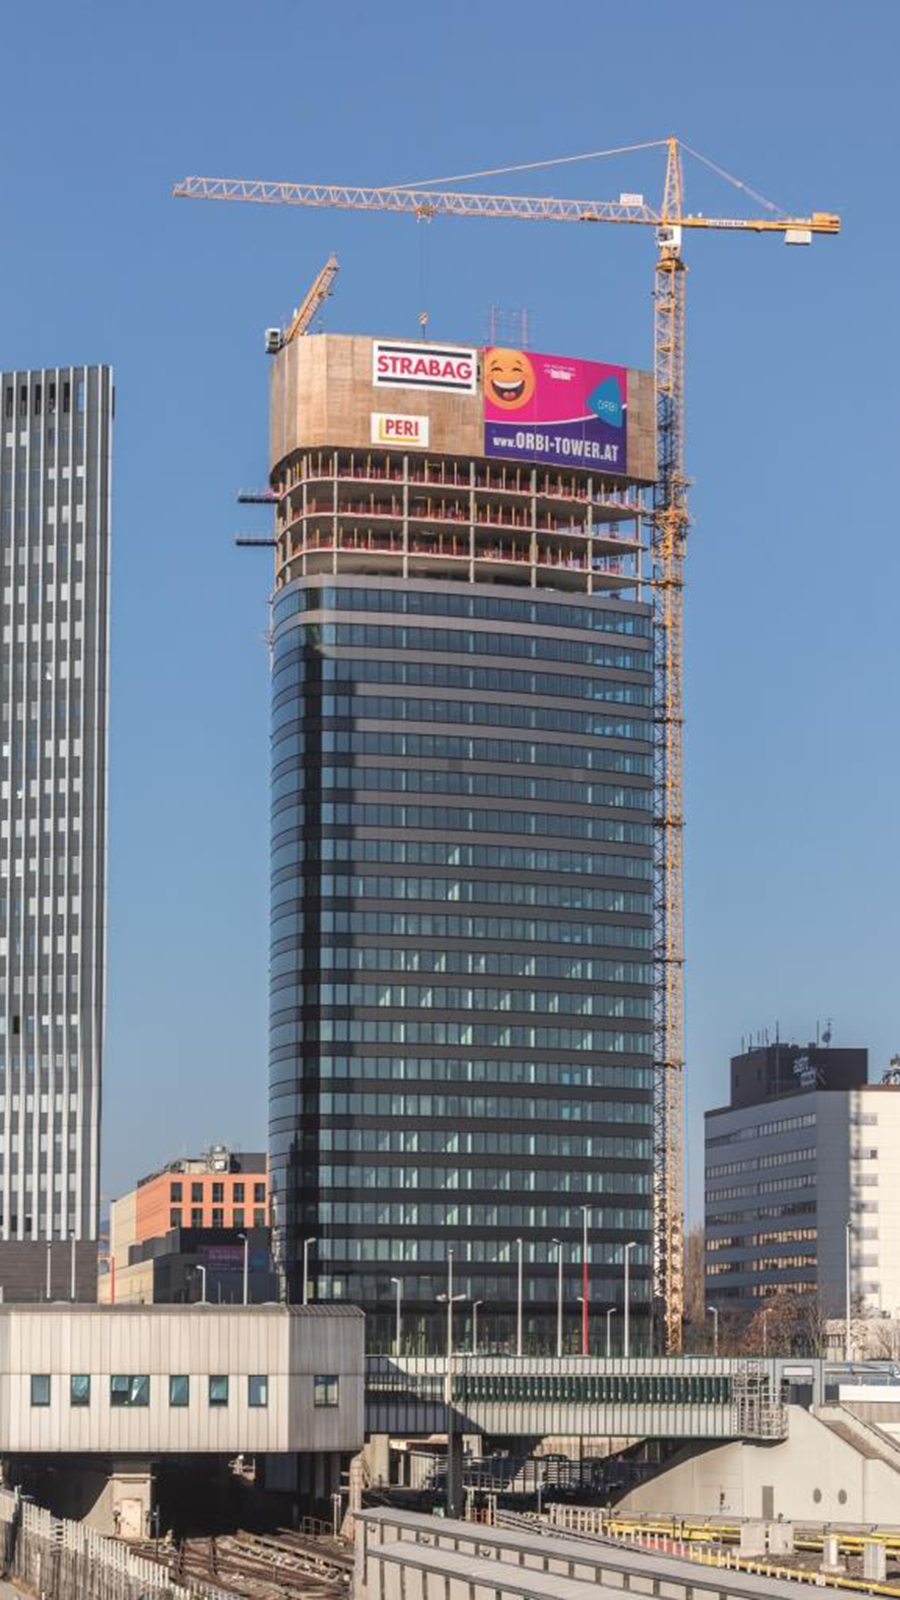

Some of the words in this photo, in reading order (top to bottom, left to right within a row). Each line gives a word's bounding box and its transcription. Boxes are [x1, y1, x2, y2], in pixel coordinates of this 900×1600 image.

[377, 355, 472, 380] STRABAG
[598, 399, 618, 412] ORBI
[385, 419, 419, 436] PERI
[493, 432, 619, 461] www.ORBI-TOWER.AT
